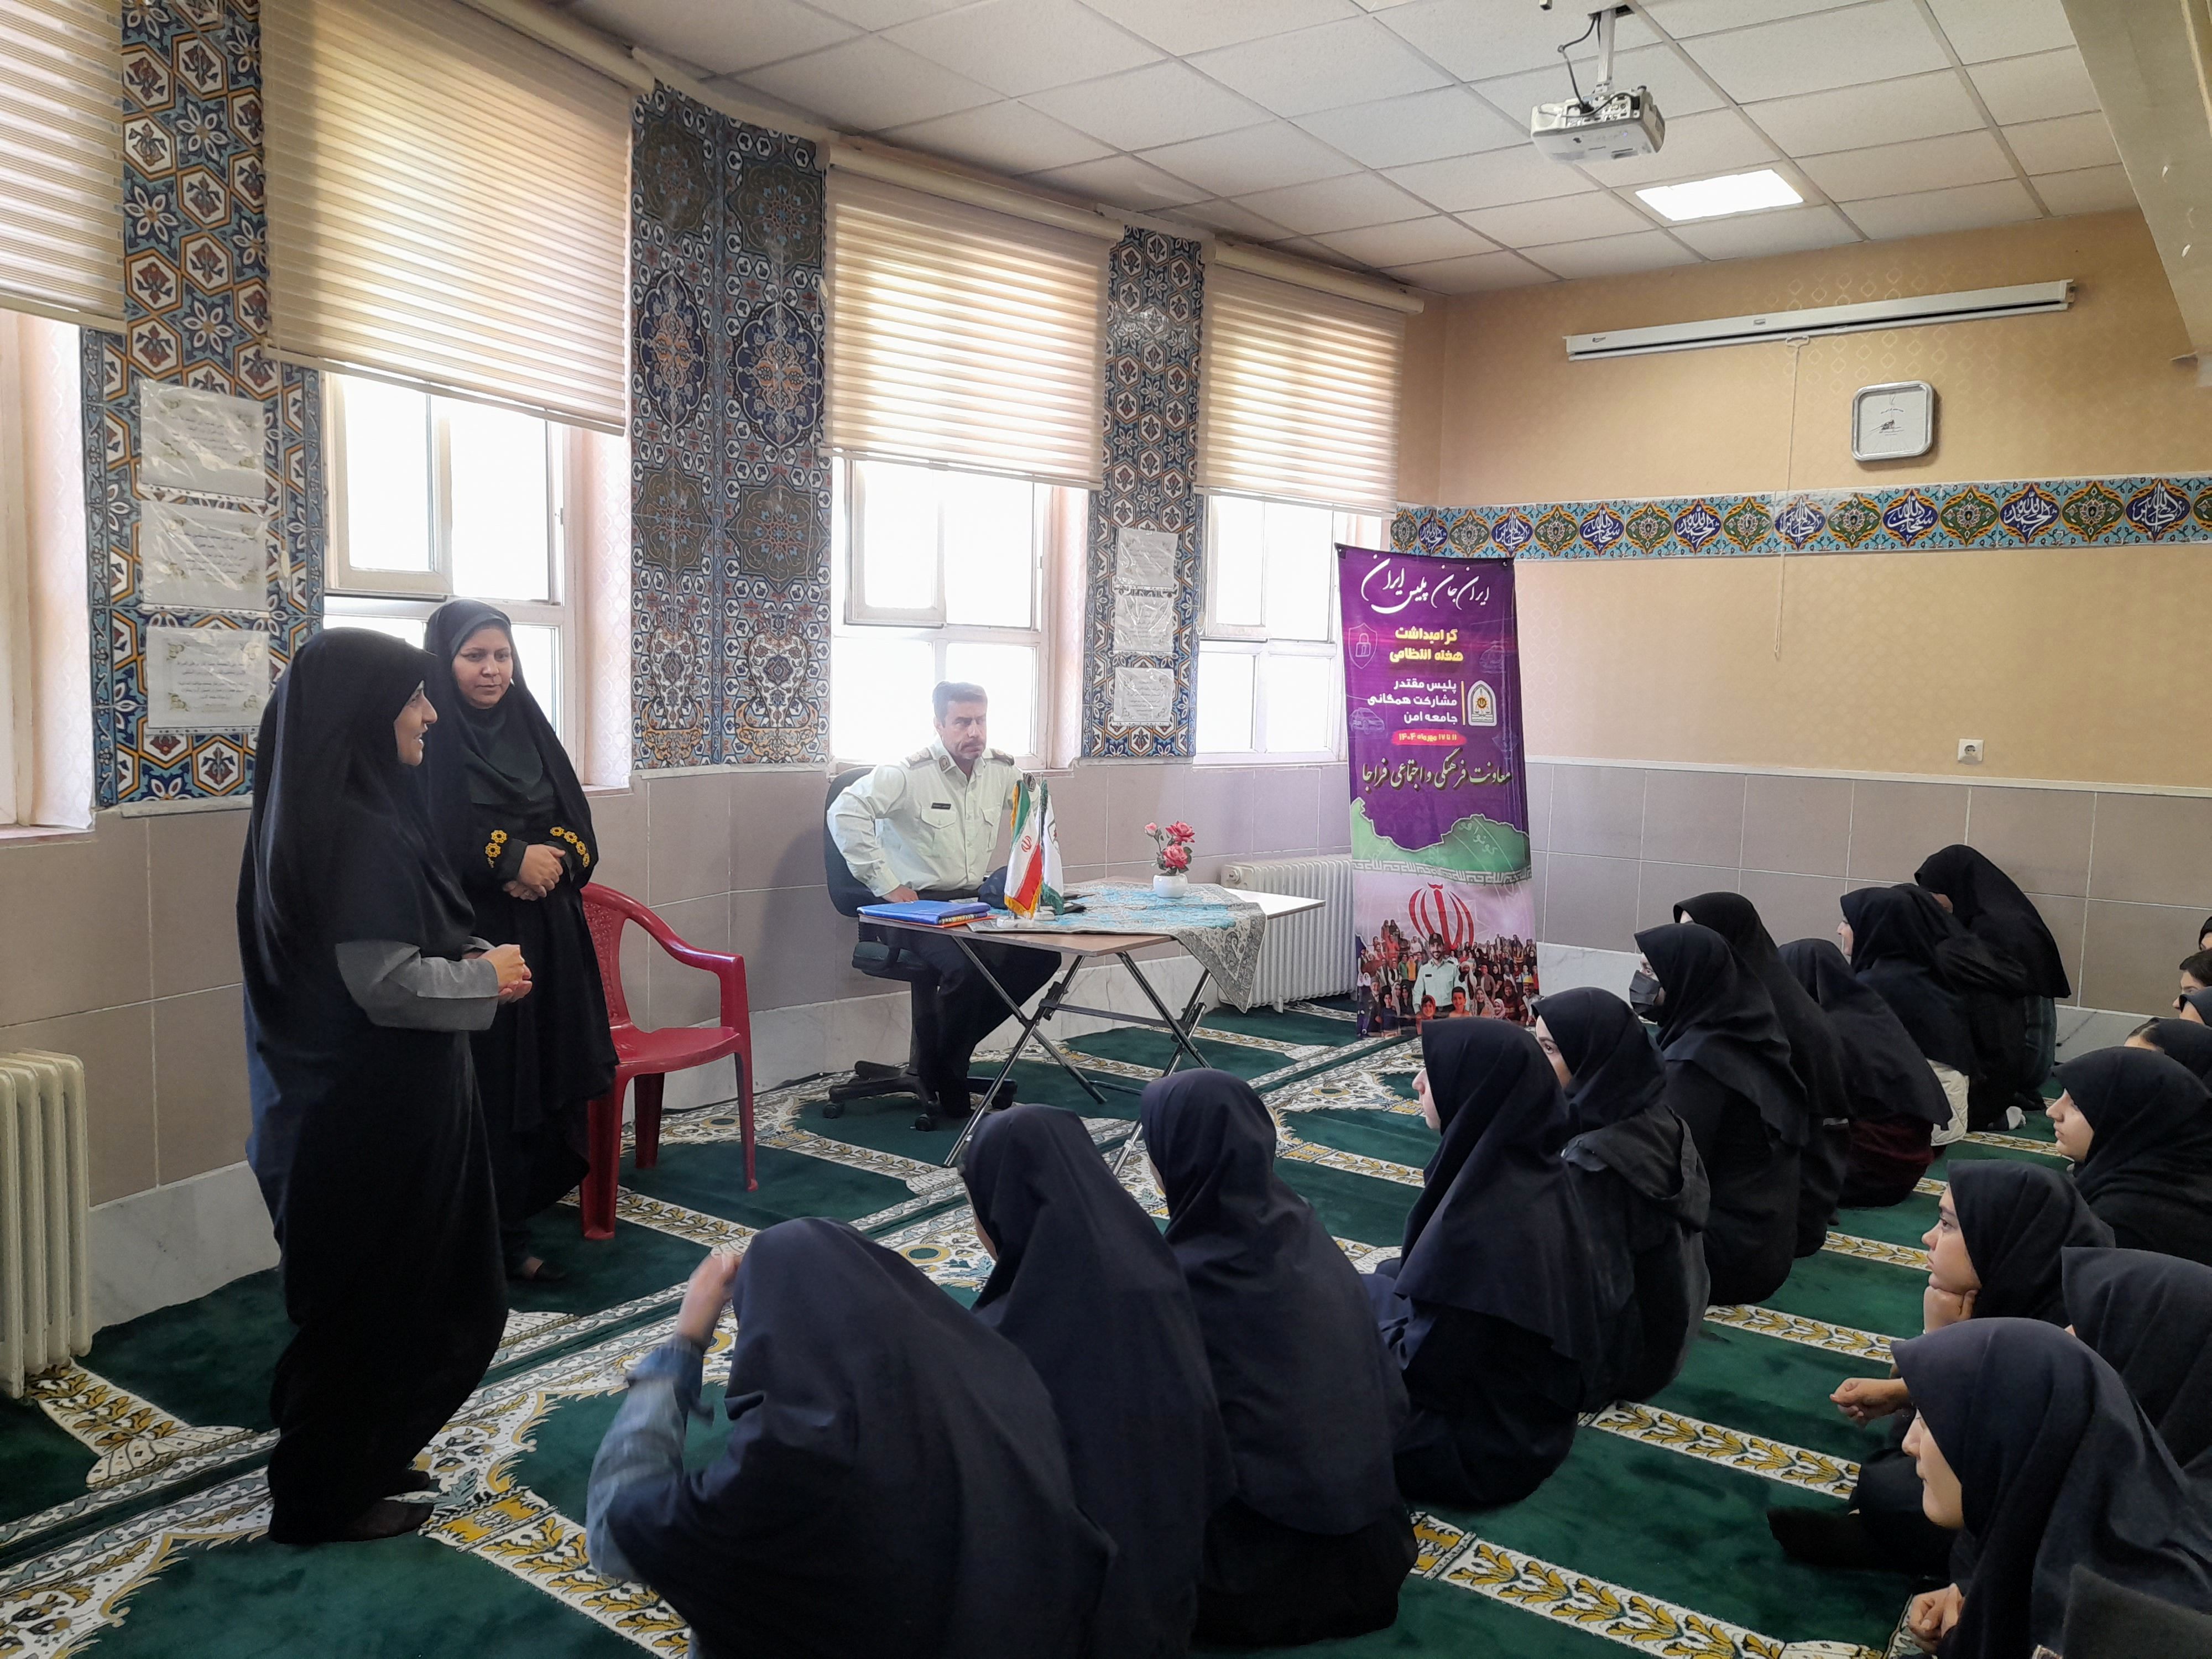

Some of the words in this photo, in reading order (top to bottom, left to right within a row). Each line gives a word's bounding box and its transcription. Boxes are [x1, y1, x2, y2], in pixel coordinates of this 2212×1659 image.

[1360, 554, 1405, 602] ایران
[1430, 564, 1458, 608] جان
[1371, 576, 1429, 614] پلیس
[1455, 566, 1490, 611] ایران
[1395, 625, 1458, 645] گرامیداشت
[1389, 647, 1432, 662] انتظامی
[1434, 649, 1464, 661] هفته
[1393, 678, 1425, 690] مقتدر
[1426, 679, 1457, 694] پلیس
[1367, 692, 1411, 706] همگانی
[1413, 694, 1458, 708] مشارکت
[1404, 711, 1423, 724] امن
[1425, 712, 1458, 725] جامعه
[1362, 757, 1388, 792] فراجا
[1390, 759, 1423, 790] اجتماعی
[1433, 747, 1467, 788] فرهنگی
[1469, 761, 1511, 784] معاونت
[1426, 771, 1433, 783] و
